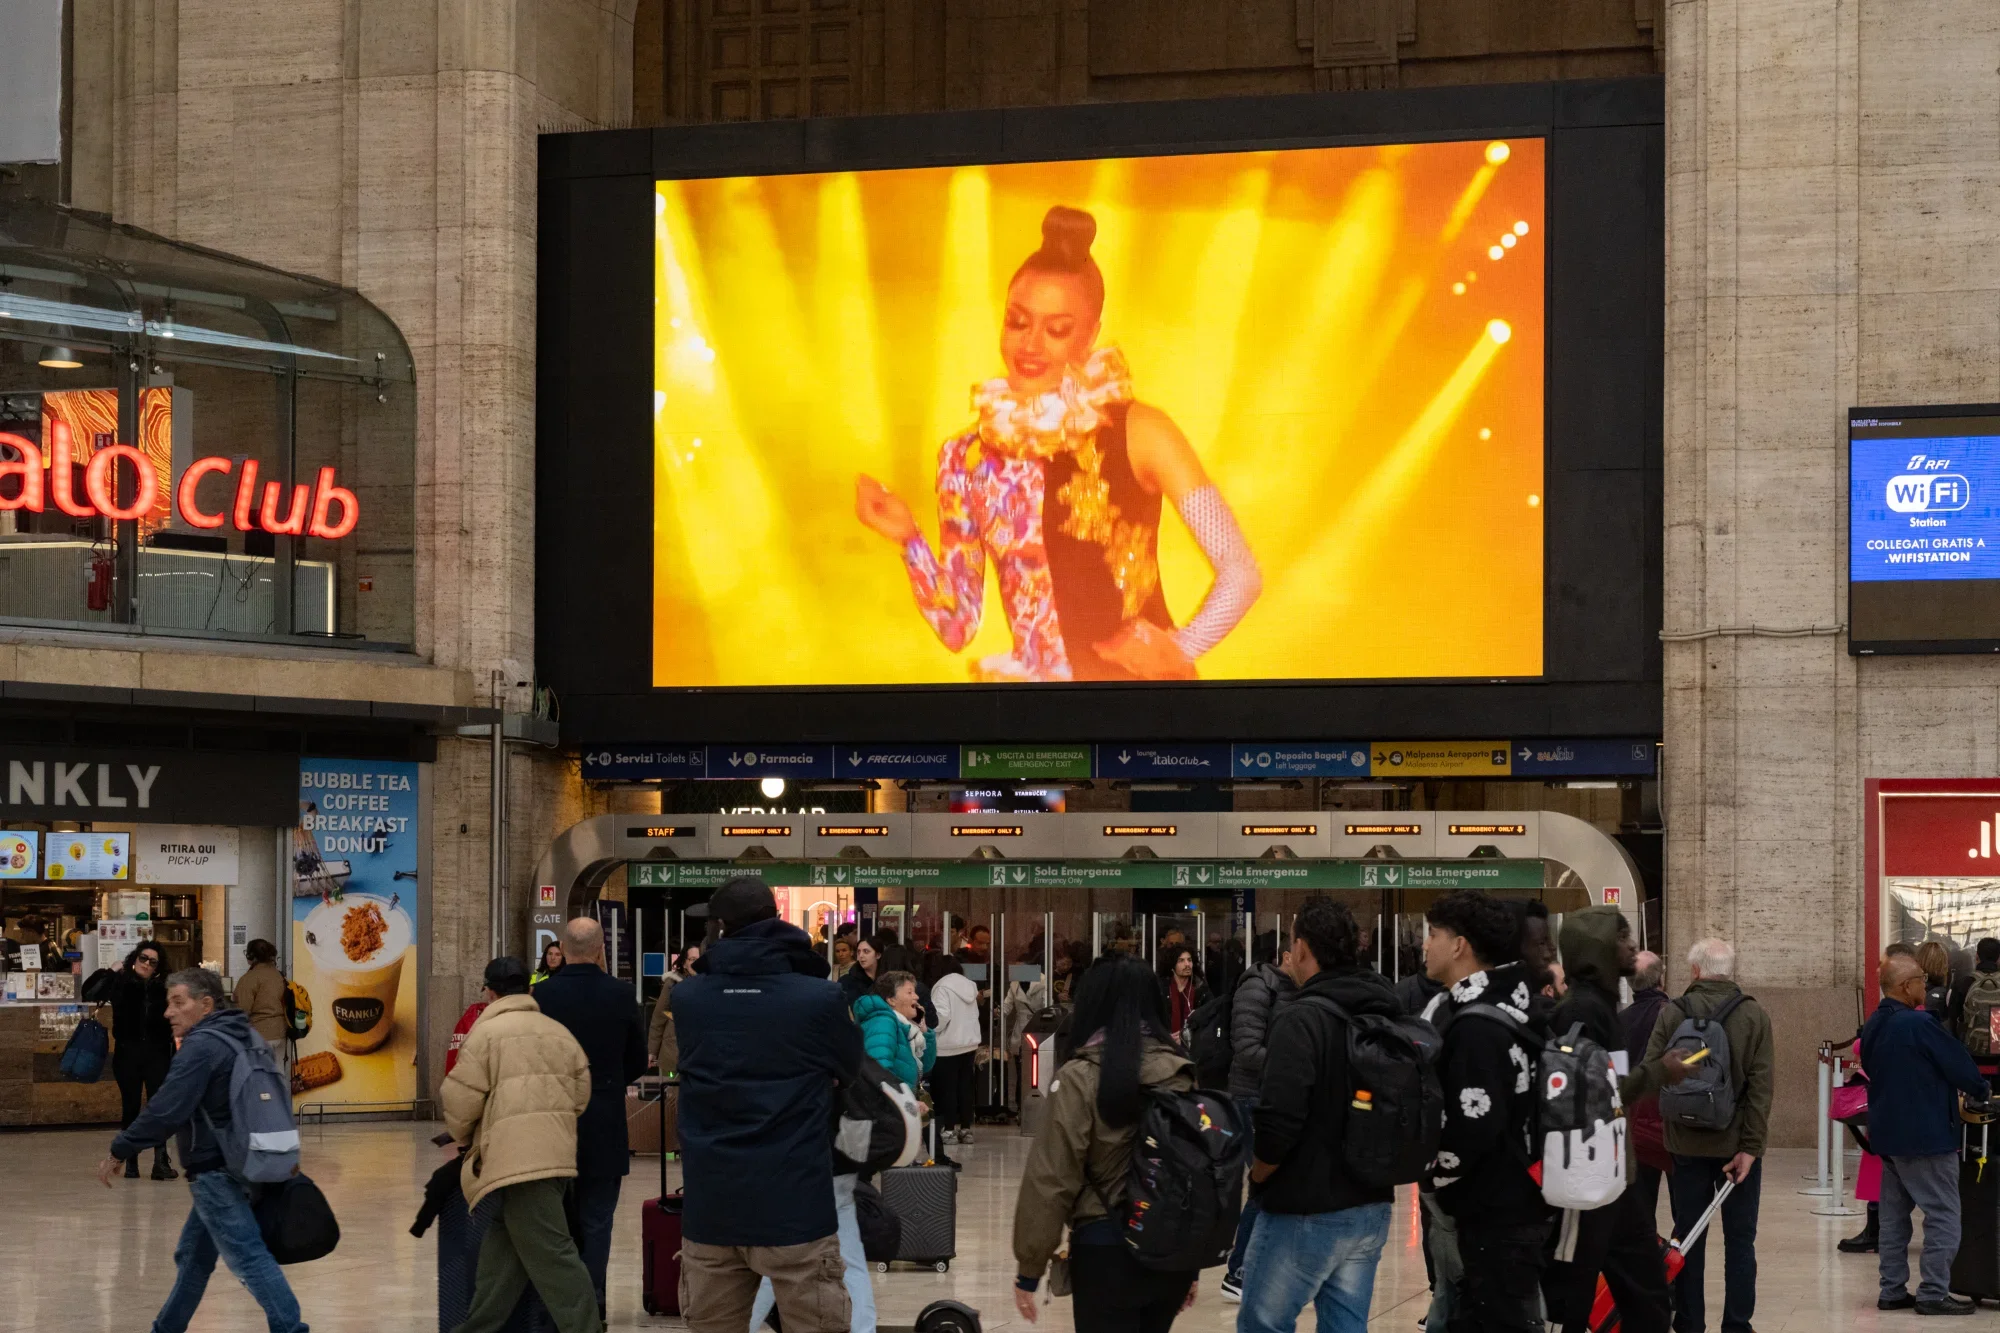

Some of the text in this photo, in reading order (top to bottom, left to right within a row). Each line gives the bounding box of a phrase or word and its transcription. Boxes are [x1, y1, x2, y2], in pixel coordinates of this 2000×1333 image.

[1925, 460, 1950, 470] RFI
[178, 456, 359, 539] Club
[1910, 517, 1946, 528] Station
[1866, 538, 1986, 550] COLLEGATI GRATIS A
[1884, 552, 1970, 564] .WIFISTATION
[615, 752, 686, 764] Servizi Toilets
[760, 753, 814, 764] Farmacia
[997, 752, 1084, 760] USCITA DI EMERGENZA
[1276, 752, 1347, 762] Deposito Bagagli
[1406, 750, 1489, 760] Malpensa Aeroporto
[1008, 760, 1072, 768] EMERGENCY EXIT
[1440, 761, 1464, 769] Airport
[0, 760, 161, 808] NKLY
[301, 772, 411, 792] BUBBLE TEA
[323, 794, 389, 812] COFFEE
[303, 814, 408, 834] BREAKFAST
[648, 828, 674, 836] STAFF
[160, 844, 216, 856] RITIRA QUI
[324, 836, 388, 854] DONUT
[168, 856, 209, 866] PICK-UP
[680, 866, 762, 877] Sola Emergenza
[854, 867, 939, 877] Sola Emergenza
[1035, 867, 1121, 877] Sola Emergenza
[1219, 867, 1308, 877] Sola Emergenza
[1408, 867, 1499, 878] Sola Emergenza
[854, 877, 902, 885] Emergency Only
[1035, 877, 1083, 885] Emergency Only
[1219, 877, 1268, 885] Emergency Only
[1408, 878, 1458, 886] Emergency Only
[534, 914, 560, 924] GATE
[336, 1006, 380, 1019] FRANKLY
